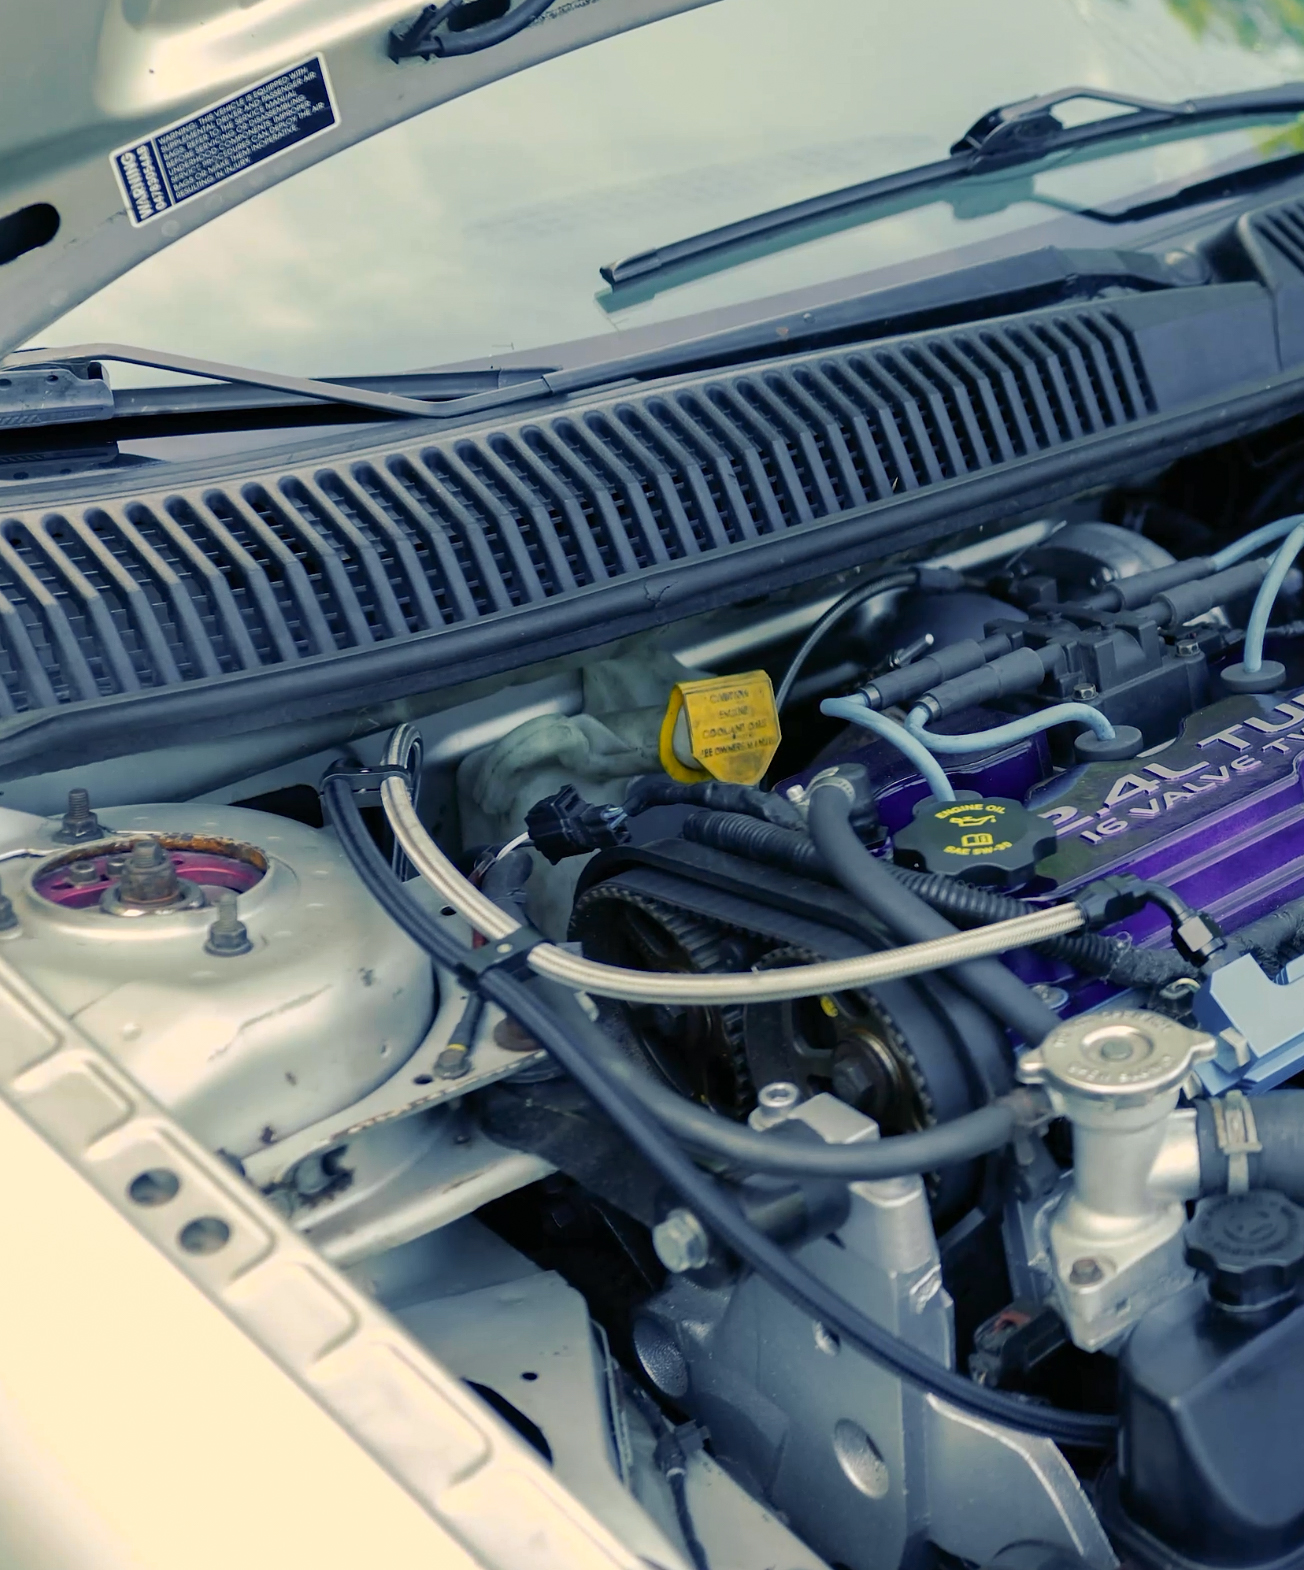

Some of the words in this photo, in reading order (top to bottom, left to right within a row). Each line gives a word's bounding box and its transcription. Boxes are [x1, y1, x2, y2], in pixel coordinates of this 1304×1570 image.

[160, 121, 214, 152] SUPPLEMENTAL
[216, 107, 242, 125] DRIVER
[244, 98, 260, 111] AND
[261, 77, 302, 102] PASSENGER
[303, 71, 316, 82] AIR
[186, 133, 208, 148] REFER
[209, 128, 219, 137] TO
[221, 121, 233, 131] THE
[234, 106, 263, 124] SERVICE
[265, 89, 296, 109] MANUAL
[198, 113, 213, 124] THIS
[214, 97, 244, 116] VEHICLE
[245, 93, 252, 101] IS
[253, 75, 288, 97] EQUIPPED
[289, 66, 306, 79] WITH
[166, 149, 194, 167] BEFORE
[195, 129, 234, 153] SERVICING
[235, 122, 247, 133] OR
[249, 93, 305, 126] DISASSEMBLING
[168, 147, 217, 175] UNDERHOOD
[273, 99, 310, 122] IMPROPER
[171, 163, 201, 183] SERVICE
[202, 138, 250, 167] PROCEDURES
[251, 129, 268, 142] CAN
[269, 115, 296, 133] DEPLOY
[298, 108, 311, 119] THE
[311, 101, 324, 112] AIR
[120, 152, 151, 218] WARNING
[173, 176, 193, 190] BAGS
[195, 169, 206, 179] OR
[207, 158, 229, 173] MAKE
[230, 147, 250, 161] THEM
[176, 175, 213, 198] RESULTING
[215, 170, 222, 178] IN
[935, 804, 984, 819] ENGINE
[986, 805, 1005, 814] OIL
[1038, 760, 1210, 836] 2.4L
[1080, 818, 1129, 845] 16
[1128, 754, 1262, 818] VALVE
[944, 846, 970, 855] SAE
